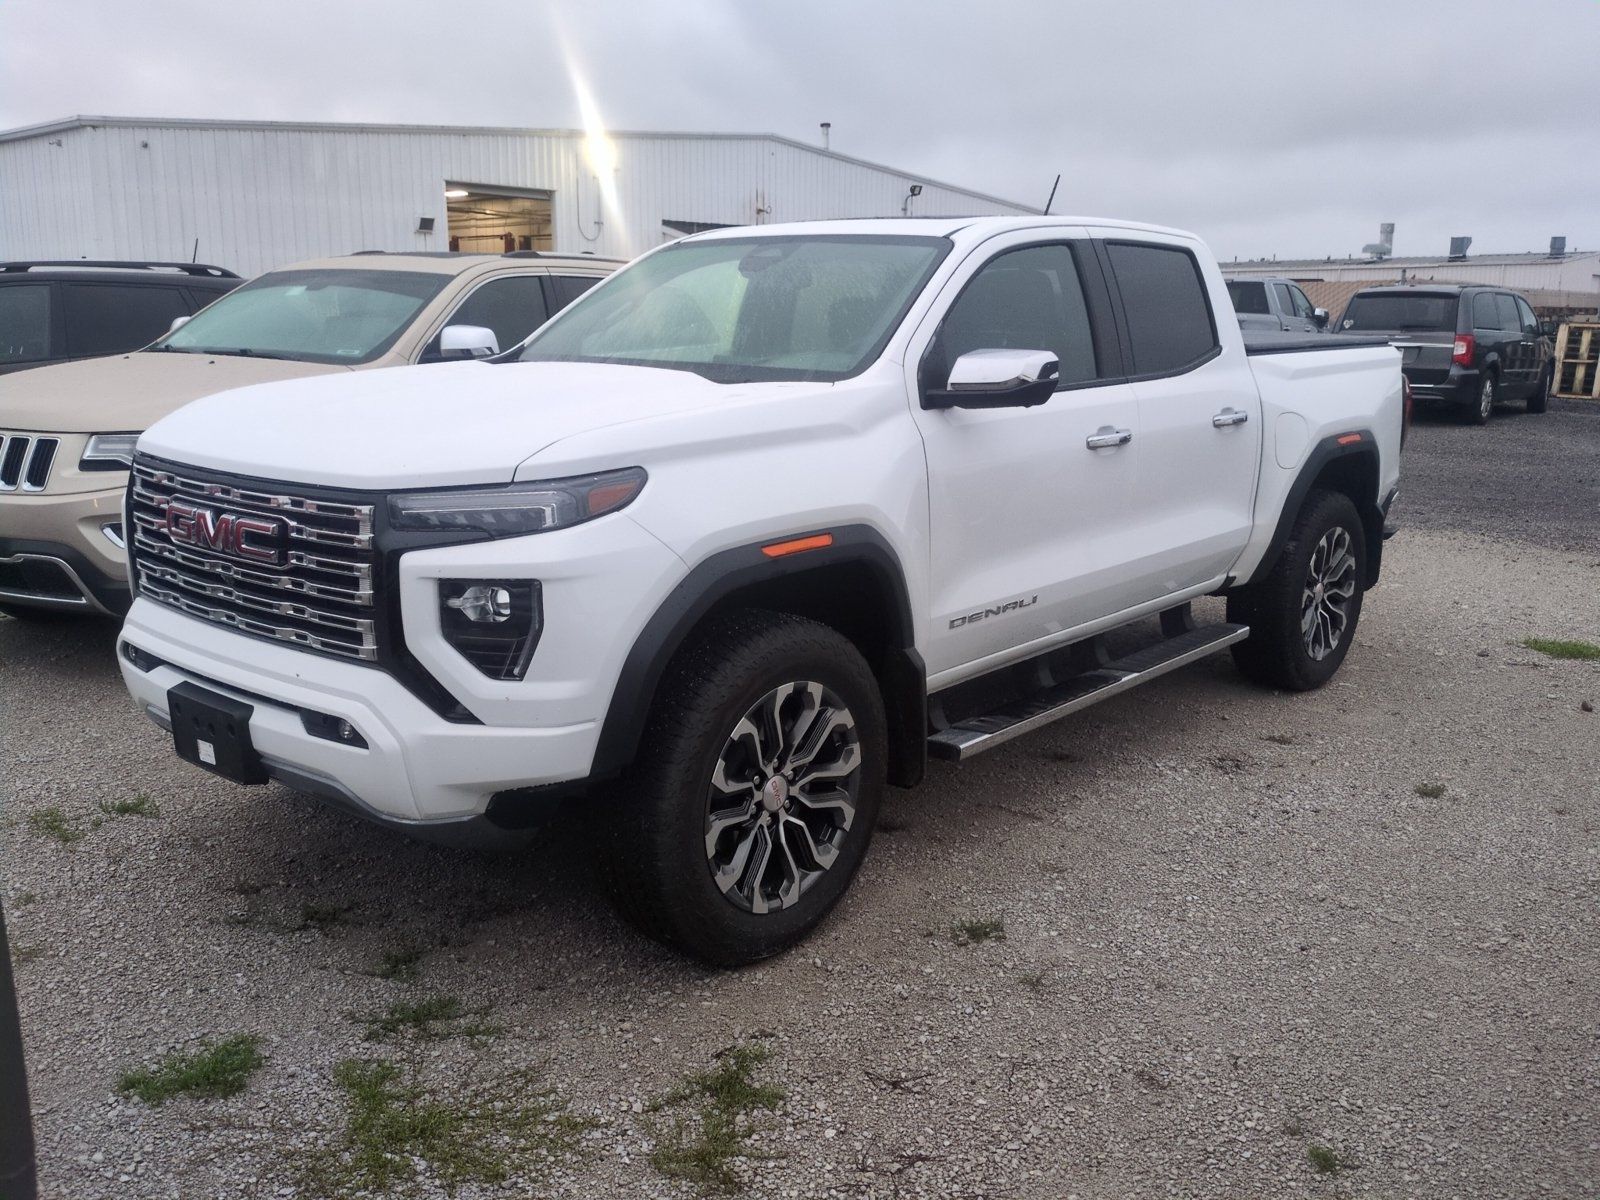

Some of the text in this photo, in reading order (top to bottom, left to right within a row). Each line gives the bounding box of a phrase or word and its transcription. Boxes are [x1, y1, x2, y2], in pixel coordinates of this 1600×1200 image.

[166, 502, 279, 563] GMC
[949, 594, 1038, 630] DENALI
[771, 781, 782, 807] GMC
